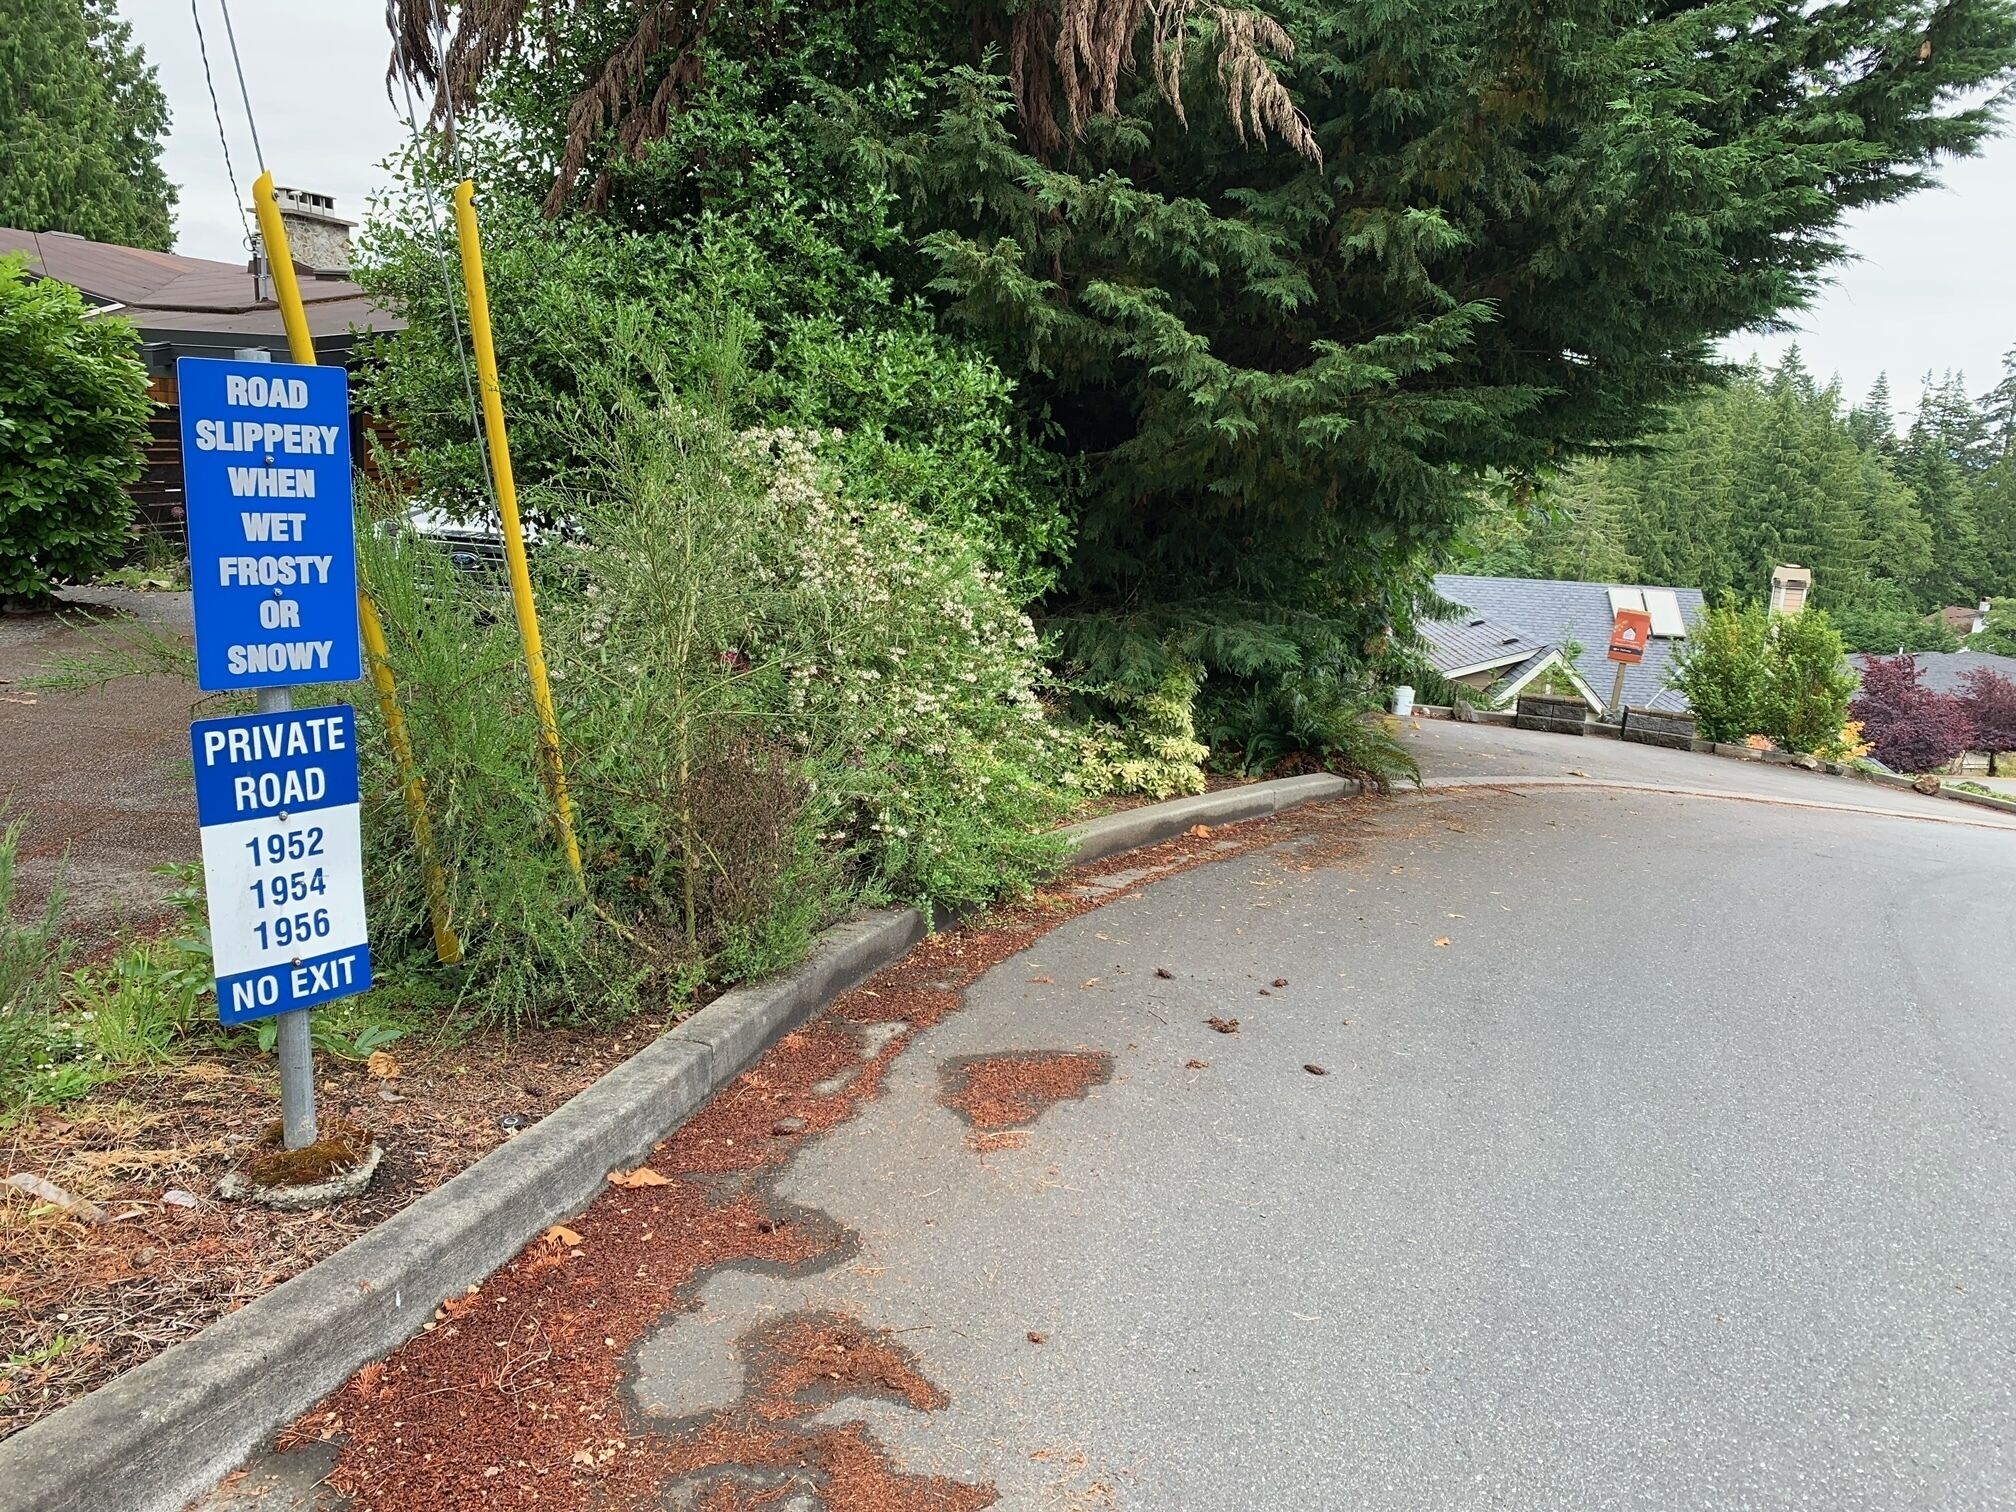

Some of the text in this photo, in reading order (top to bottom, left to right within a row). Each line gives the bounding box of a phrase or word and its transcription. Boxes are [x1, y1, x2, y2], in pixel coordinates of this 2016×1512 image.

[226, 375, 308, 409] ROAD
[196, 419, 339, 455] SLIPPERY
[227, 467, 315, 498] WHEN
[241, 512, 306, 542] WET
[219, 555, 333, 587] FROSTY
[259, 599, 300, 629] OR
[227, 640, 333, 675] SNOWY
[204, 716, 345, 766] PRIVATE
[234, 767, 325, 811] ROAD
[245, 826, 324, 867] 1952
[250, 867, 326, 909] 1954
[253, 908, 330, 950] 1956
[232, 955, 356, 1012] NO EXIT
